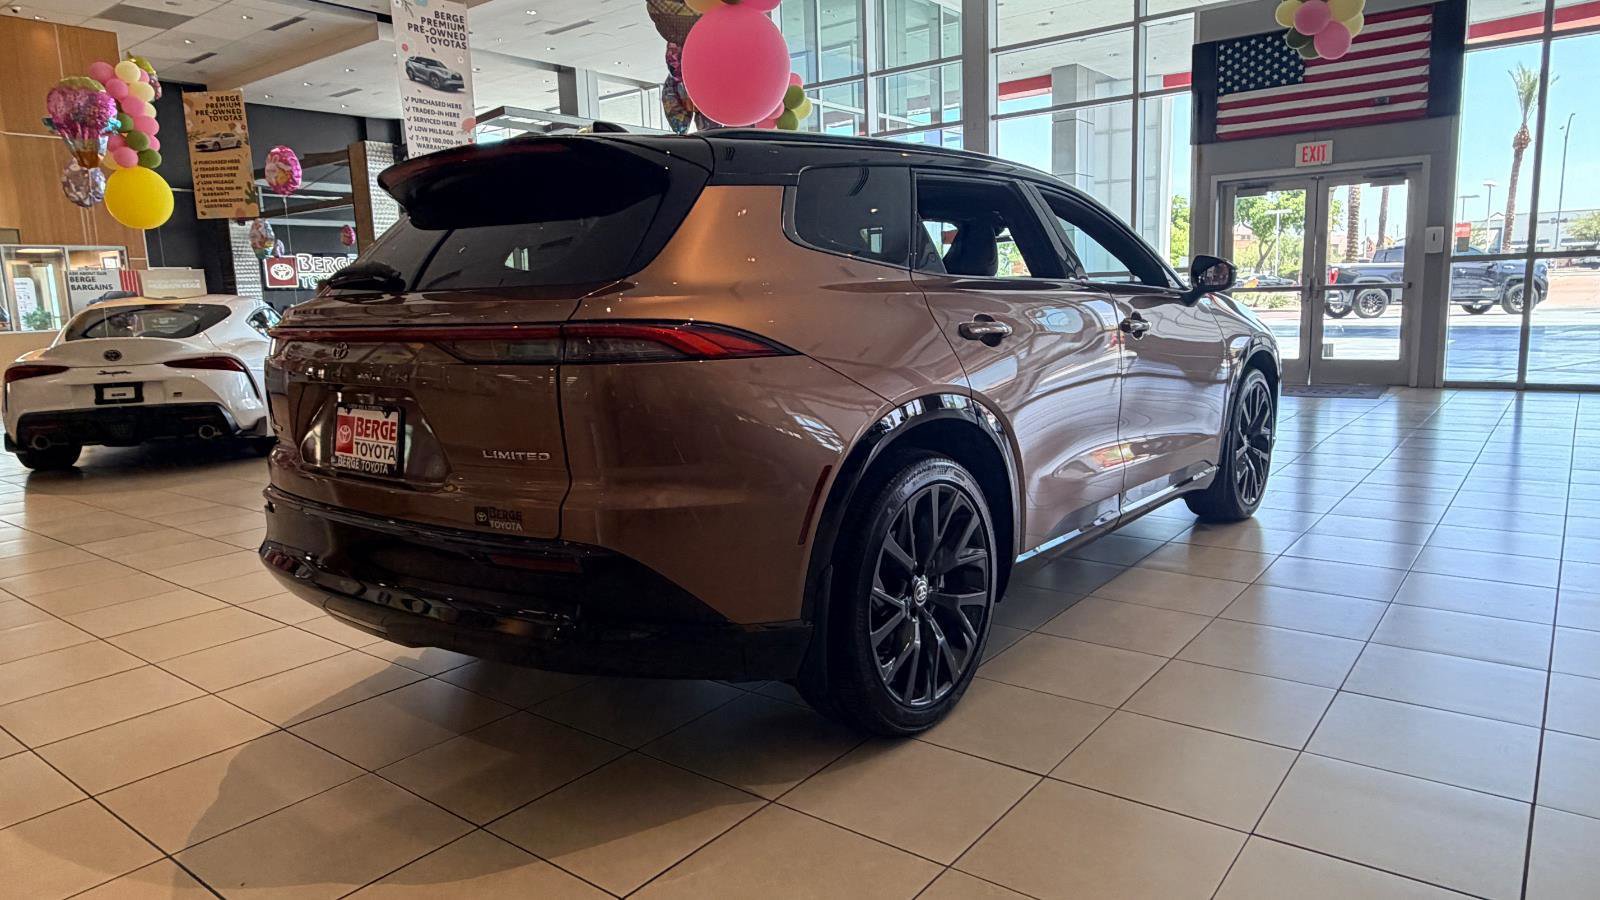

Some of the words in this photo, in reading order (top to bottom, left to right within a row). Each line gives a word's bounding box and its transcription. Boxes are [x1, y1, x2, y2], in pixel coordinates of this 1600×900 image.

[420, 16, 466, 32] PREMIUM
[434, 10, 464, 24] BERGE
[408, 22, 466, 41] PRE-OWNED
[425, 35, 467, 50] TOYOTAS
[411, 96, 446, 107] PURCHASED
[412, 106, 444, 116] TRADED-IN
[413, 116, 440, 125] SERVICED
[429, 128, 454, 136] MILEAGE
[1302, 143, 1328, 162] EXIT
[356, 416, 397, 442] BERGE
[354, 442, 396, 461] TOYOTA
[482, 450, 551, 461] LIMITED
[338, 456, 360, 469] BERGE
[361, 460, 388, 474] TOYOTA
[488, 506, 522, 520] BERGE
[490, 520, 523, 531] TOYOTA
